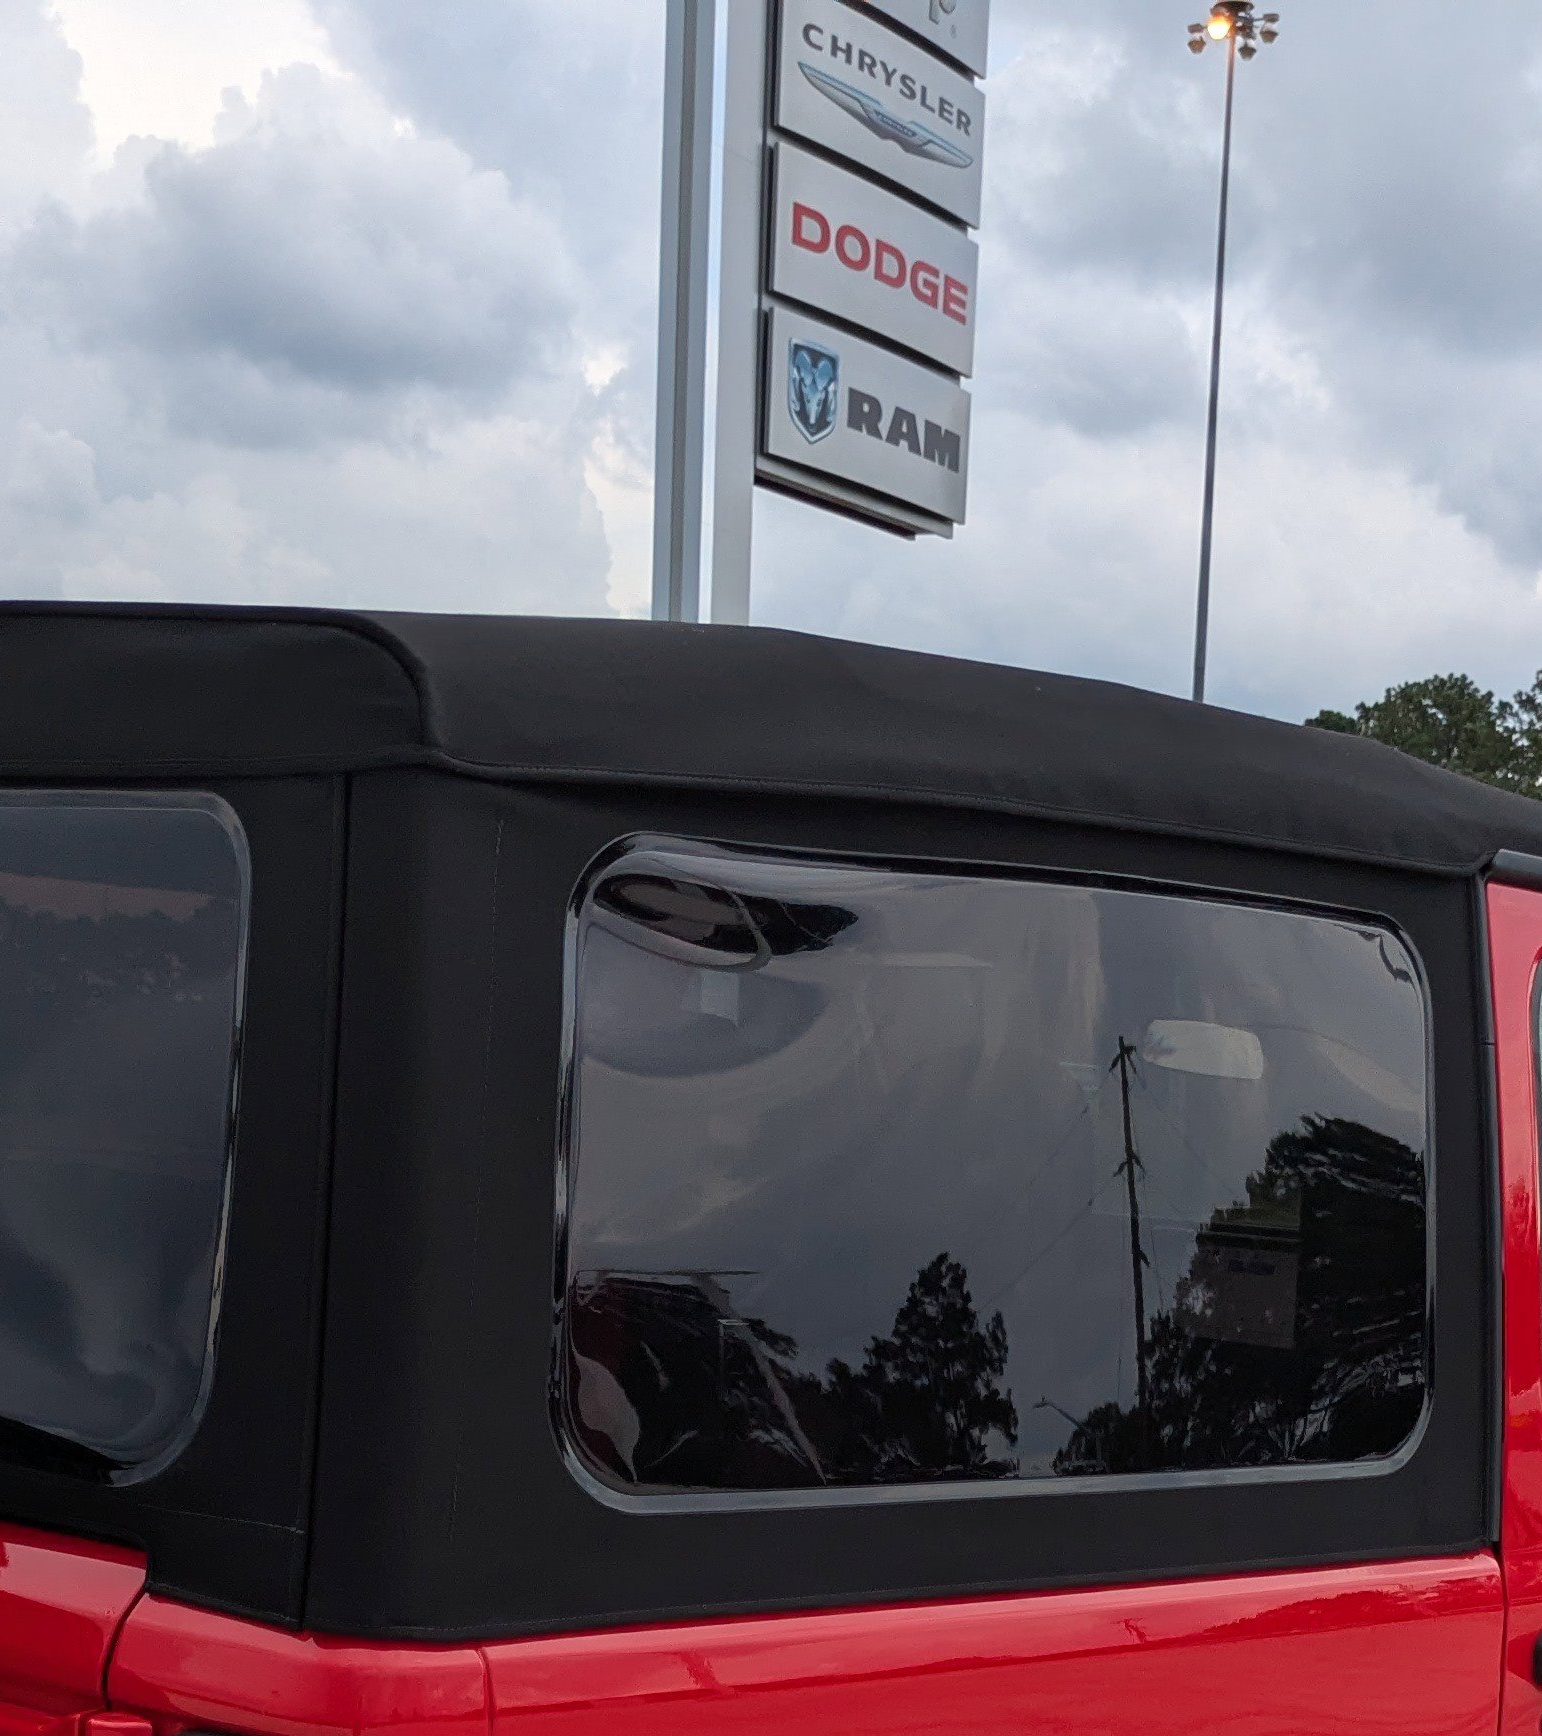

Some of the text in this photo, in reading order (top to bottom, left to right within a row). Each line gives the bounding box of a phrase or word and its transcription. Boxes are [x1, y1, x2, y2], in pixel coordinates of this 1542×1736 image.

[802, 23, 972, 138] CHRYSLER
[791, 202, 969, 326] DODGE
[847, 386, 961, 473] RAM
